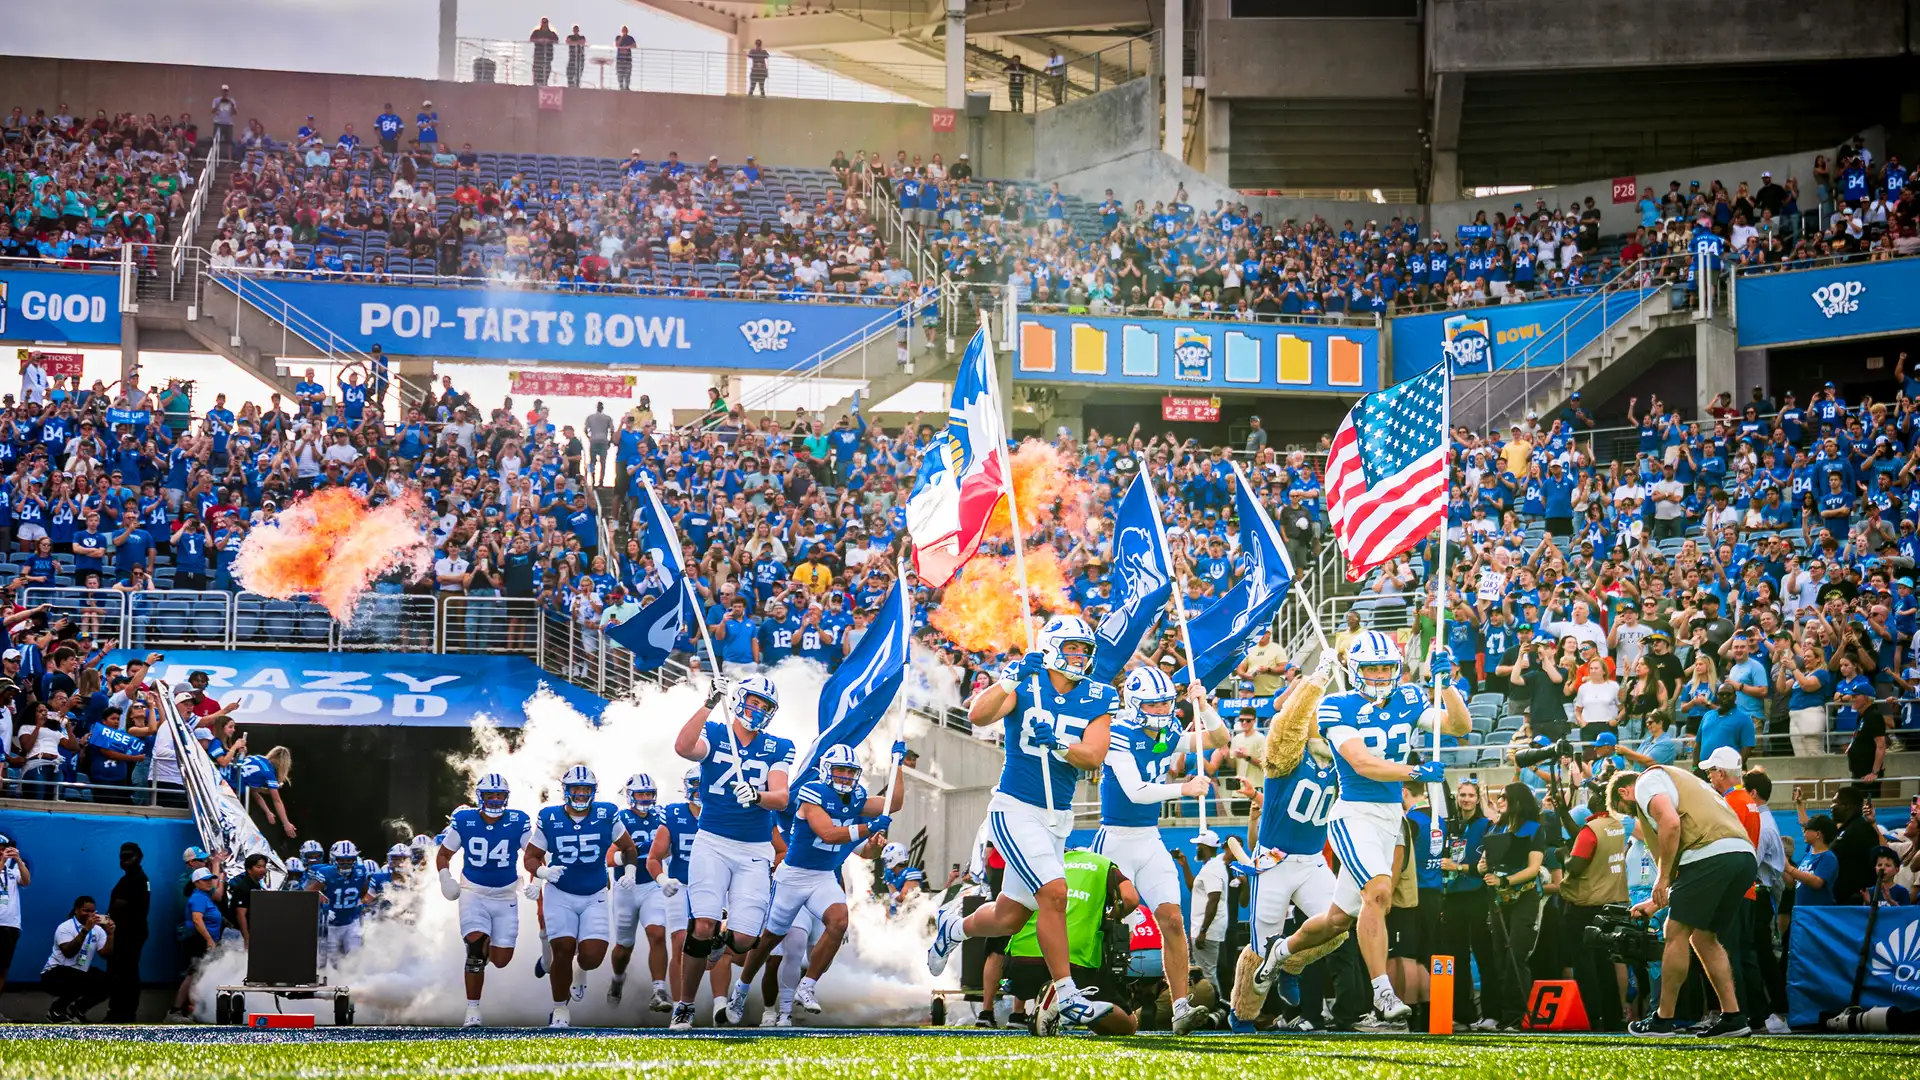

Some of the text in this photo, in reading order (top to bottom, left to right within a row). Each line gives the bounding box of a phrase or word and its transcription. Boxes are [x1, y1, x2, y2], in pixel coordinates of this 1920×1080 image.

[933, 114, 954, 127] P27
[1613, 183, 1636, 198] P28
[1697, 241, 1718, 256] 84
[1412, 262, 1427, 274] 84
[1431, 260, 1447, 272] 84
[21, 291, 106, 322] GOOD
[360, 303, 691, 349] POP-TARTS BOWL
[1497, 324, 1544, 345] BOWL
[55, 364, 61, 372] P
[66, 364, 80, 373] 25
[112, 409, 145, 420] RISE UP
[1165, 407, 1173, 415] P
[1194, 407, 1202, 416] P
[1203, 407, 1217, 416] 29
[1823, 405, 1836, 419] 19
[43, 424, 65, 443] 84
[1793, 477, 1812, 494] 84
[1526, 486, 1543, 501] 84
[21, 505, 41, 520] 84
[188, 540, 198, 554] 1
[773, 632, 793, 648] 12
[802, 632, 821, 651] 61
[124, 663, 461, 692] RAZY
[219, 689, 448, 717] OOD
[1223, 697, 1269, 708] RISE UP
[102, 727, 131, 745] RISE
[709, 751, 770, 796] 73
[1287, 779, 1337, 827] 00
[550, 812, 556, 821] A
[468, 837, 511, 868] 94
[556, 834, 601, 864] 55
[1063, 861, 1097, 871] rlando
[333, 887, 359, 909] 12
[1133, 926, 1154, 937] 193
[1531, 985, 1563, 1026] G
